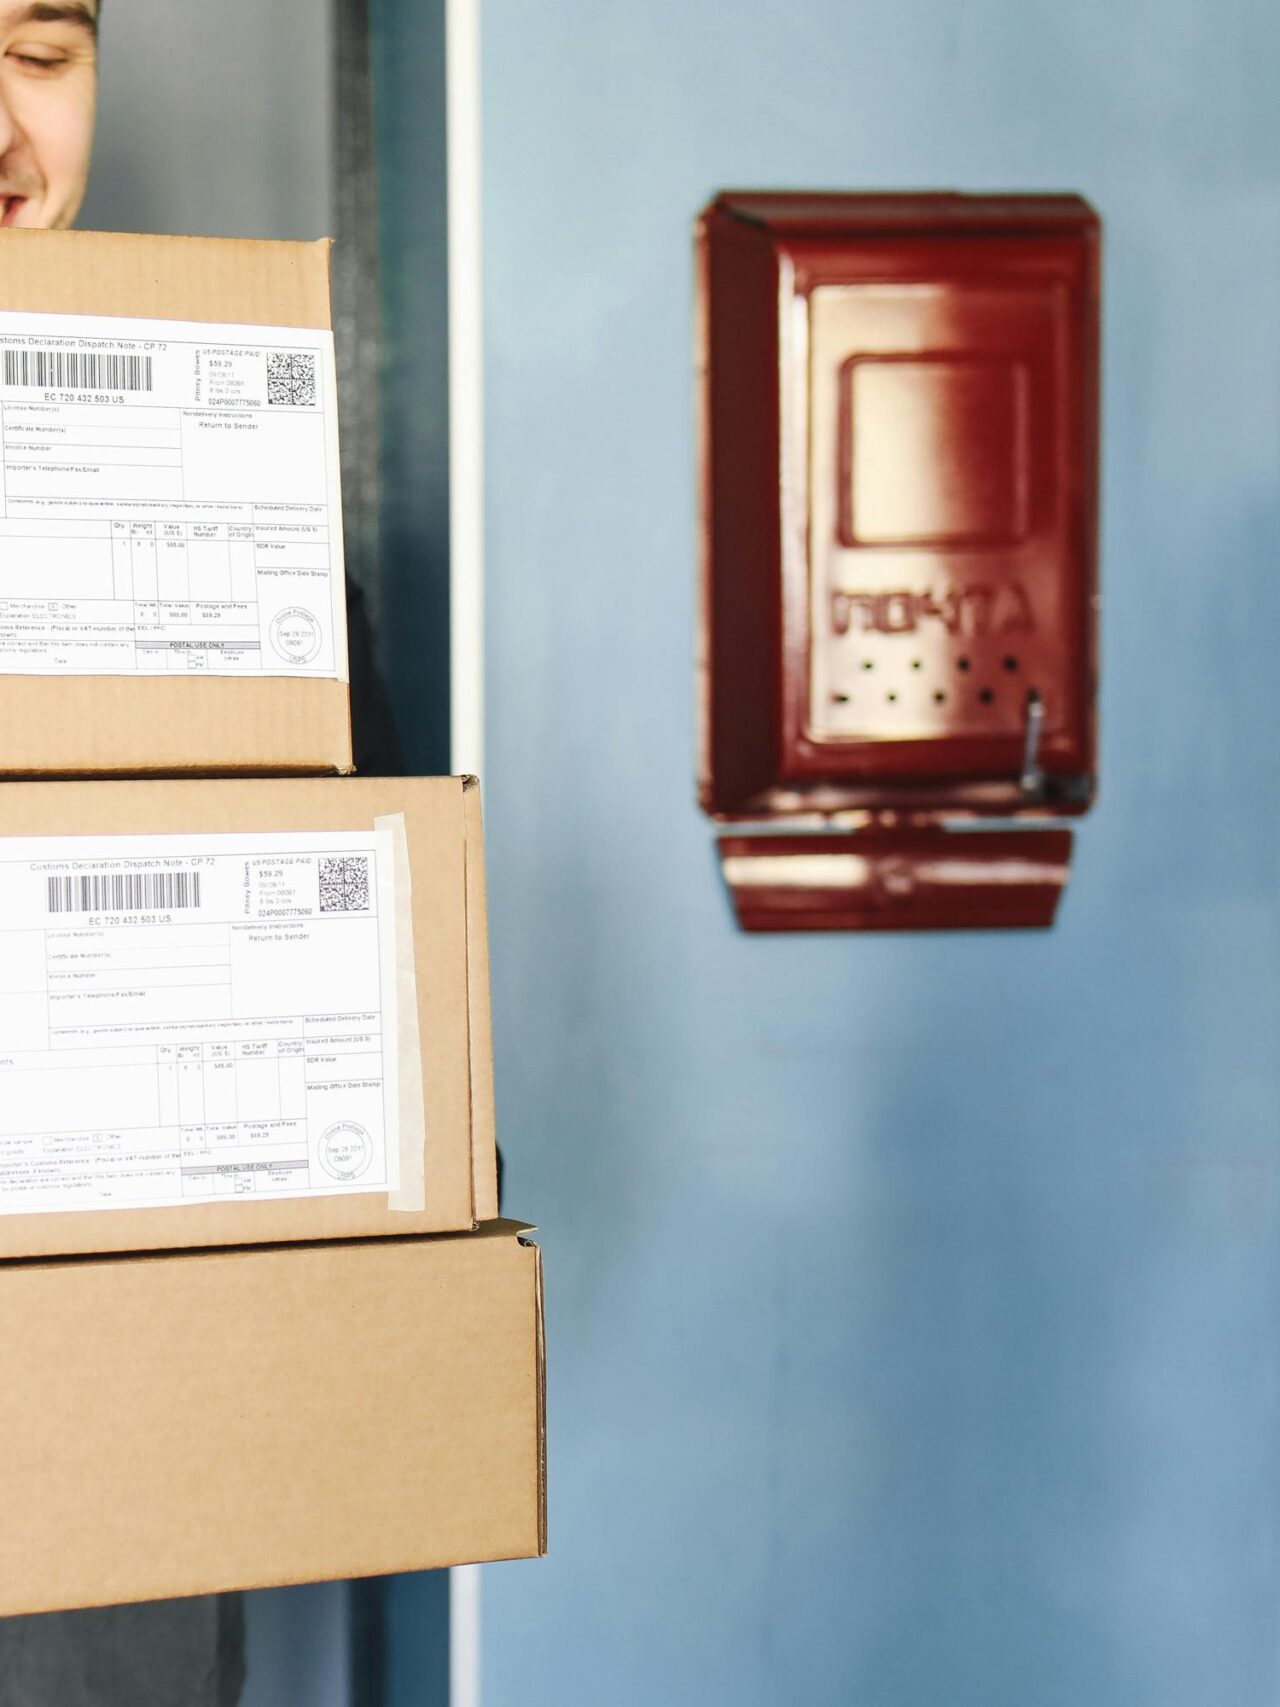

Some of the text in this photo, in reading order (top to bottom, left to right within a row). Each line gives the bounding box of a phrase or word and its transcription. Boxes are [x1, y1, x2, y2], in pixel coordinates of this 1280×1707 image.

[28, 337, 76, 348] Declaration
[78, 340, 114, 350] Dispatch
[118, 342, 136, 350] Note
[144, 342, 156, 350] CP
[158, 343, 168, 351] 72
[209, 360, 232, 368] $59.29
[194, 378, 202, 401] Pitney
[44, 393, 124, 404] EC 720 432 503 US
[198, 421, 222, 429] Return
[234, 422, 259, 430] Sender
[132, 522, 152, 530] Weight
[831, 584, 1036, 635] ПОЧТА
[30, 858, 215, 871] Customs Declaration Dispatch Note CP 72
[259, 870, 283, 878] $59.29
[89, 917, 101, 925] EC
[104, 917, 120, 925] 720
[123, 916, 138, 924] 432
[159, 915, 172, 923] US
[284, 933, 310, 941] Sender
